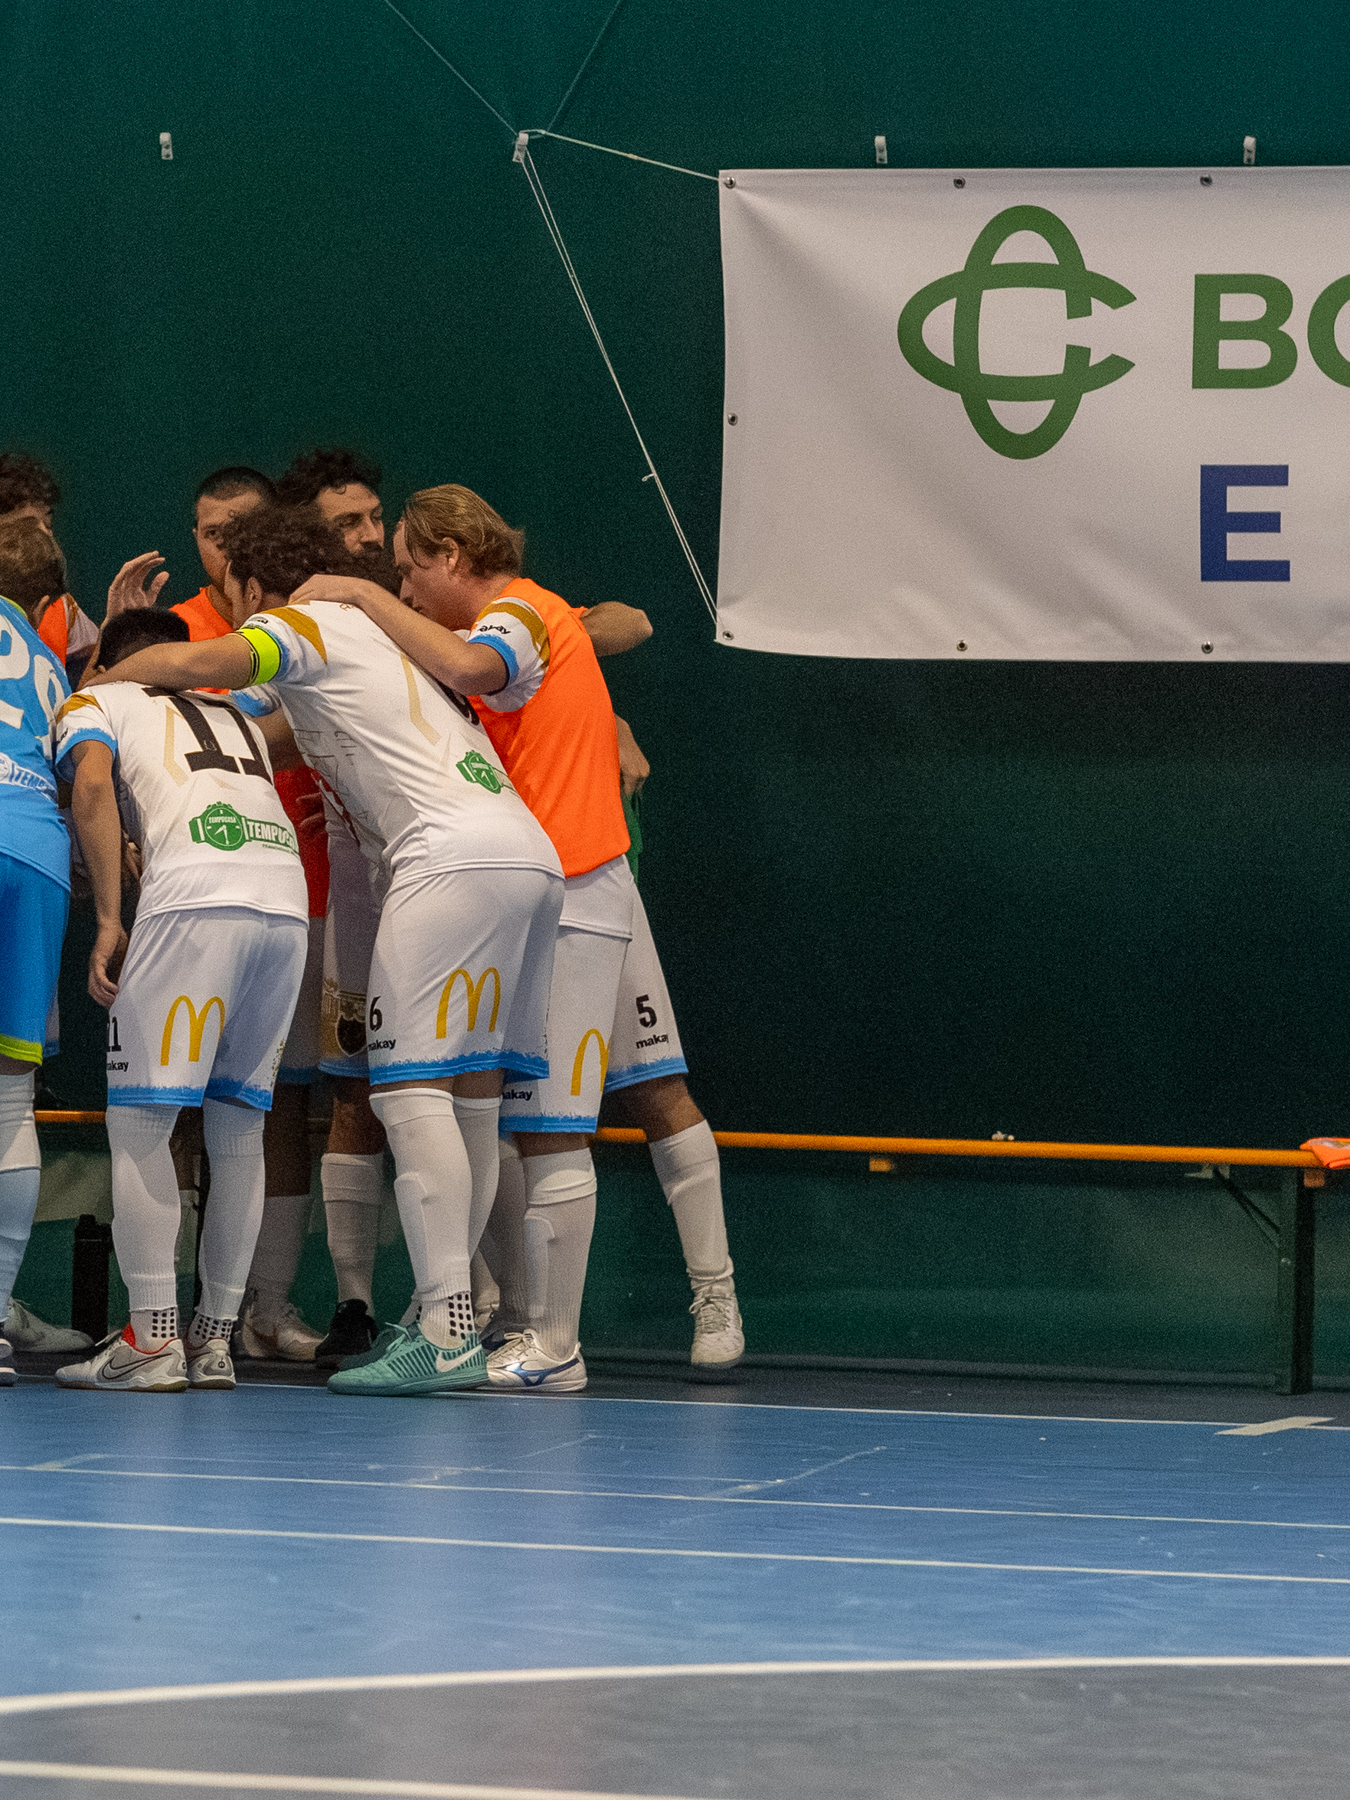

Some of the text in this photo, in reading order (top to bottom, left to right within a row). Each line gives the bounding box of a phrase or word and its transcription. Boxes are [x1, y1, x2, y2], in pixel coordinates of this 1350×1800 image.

[1200, 464, 1290, 582] E
[370, 995, 383, 1033] 6
[636, 994, 658, 1029] 5
